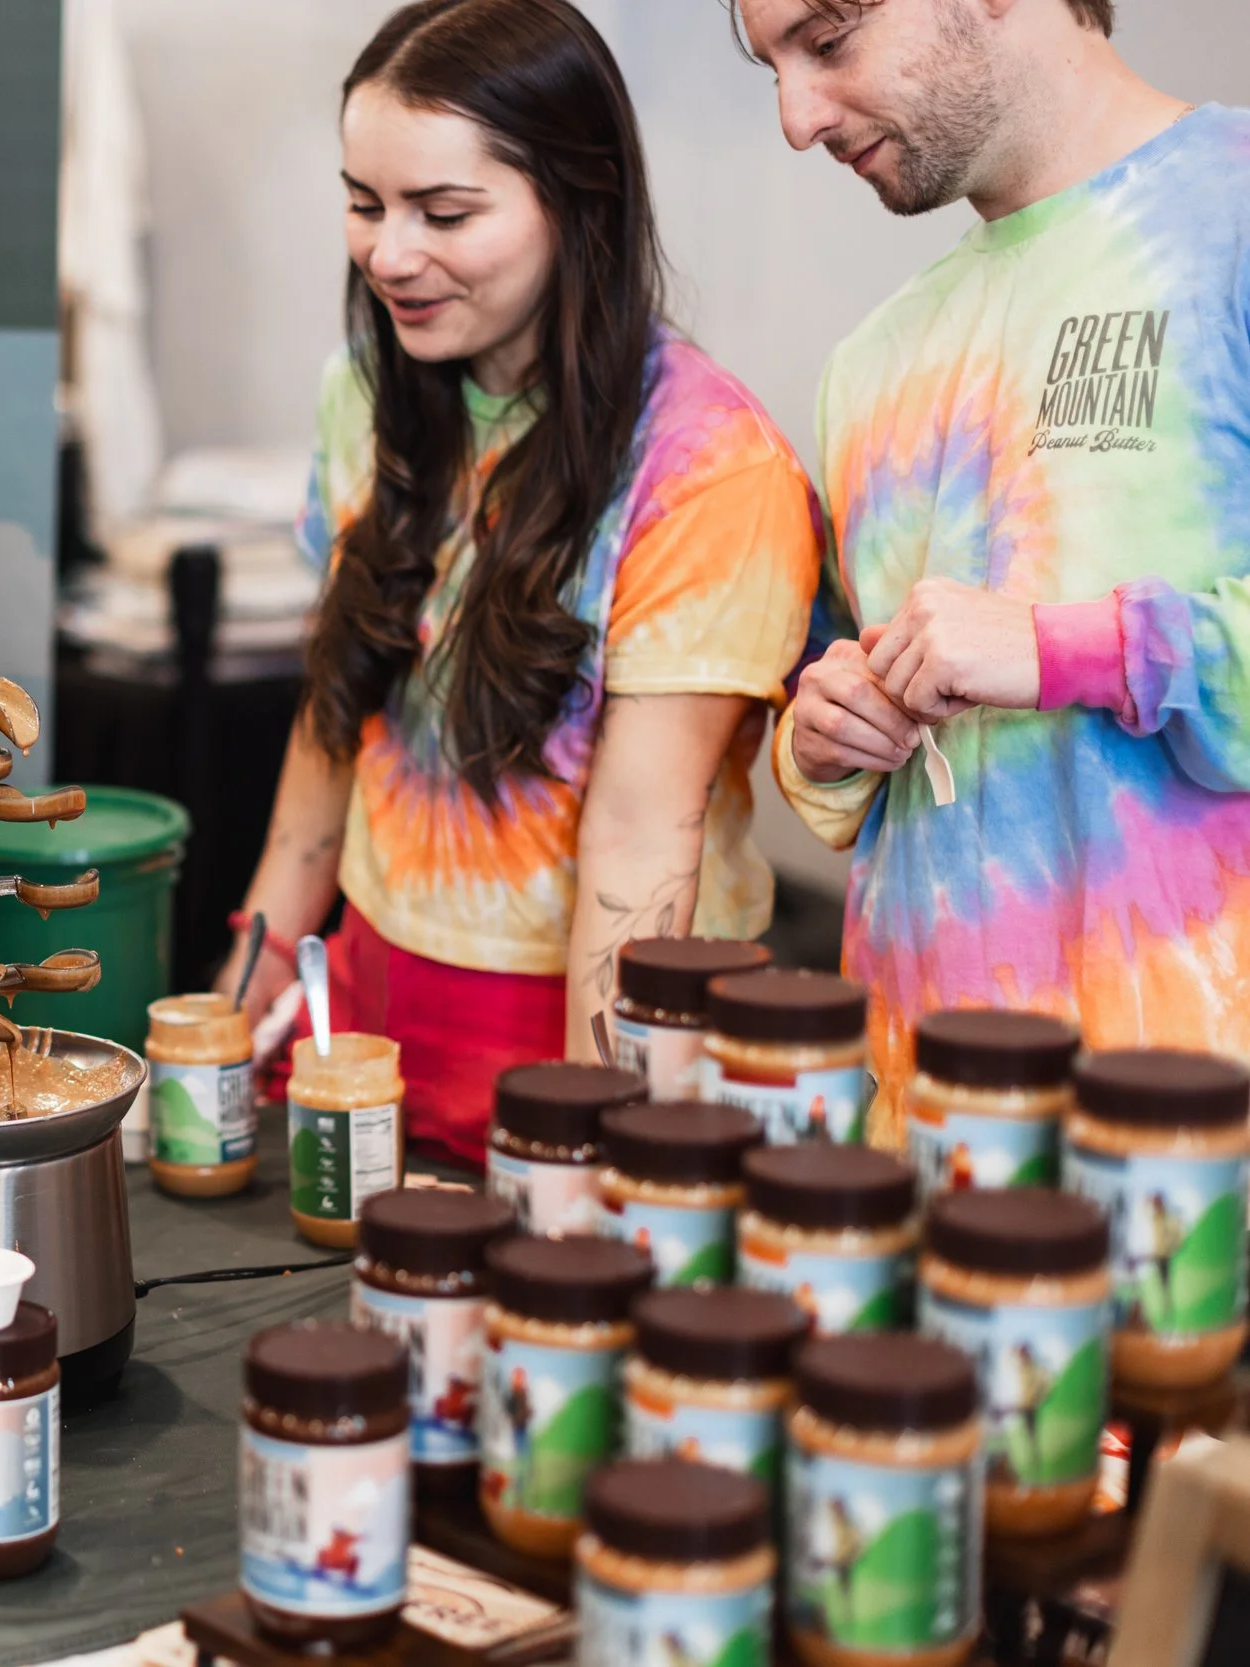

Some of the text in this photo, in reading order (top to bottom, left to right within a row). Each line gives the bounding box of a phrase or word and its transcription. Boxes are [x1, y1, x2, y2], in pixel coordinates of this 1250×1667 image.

[1046, 310, 1170, 385] GREEN
[1036, 368, 1159, 429] MOUNTAIN
[1028, 427, 1157, 456] Peanut Butter
